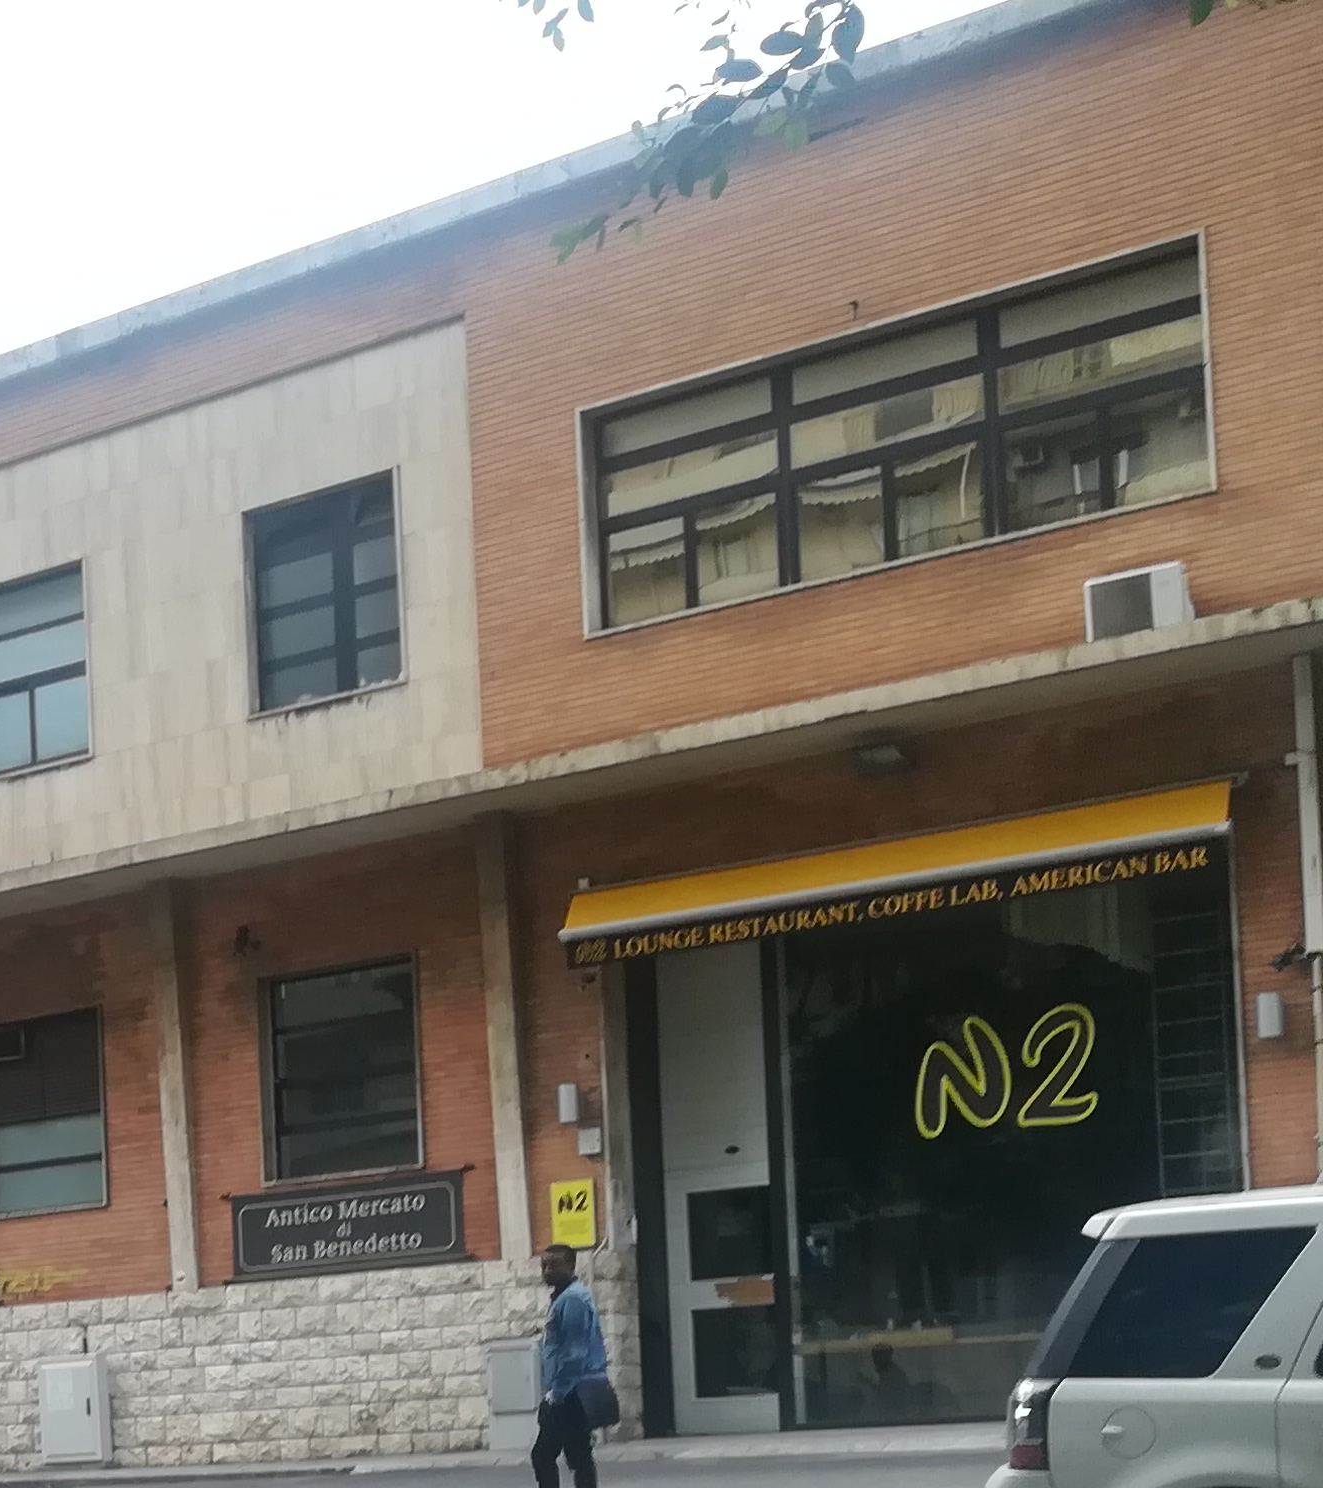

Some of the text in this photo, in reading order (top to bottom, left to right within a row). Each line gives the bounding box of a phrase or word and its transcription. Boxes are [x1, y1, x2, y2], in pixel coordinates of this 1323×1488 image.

[613, 927, 705, 960] LOUNGE
[708, 902, 864, 945] RESTAURANT,
[867, 889, 946, 920] COFFE
[950, 879, 1003, 906] LAB,
[1009, 854, 1149, 898] AMERICAN
[1153, 845, 1209, 876] BAR
[914, 1002, 1099, 1140] N2
[264, 1193, 427, 1229] Antico Mercato
[558, 1188, 590, 1216] N2
[336, 1221, 353, 1239] di
[270, 1232, 423, 1265] San Benedetto
